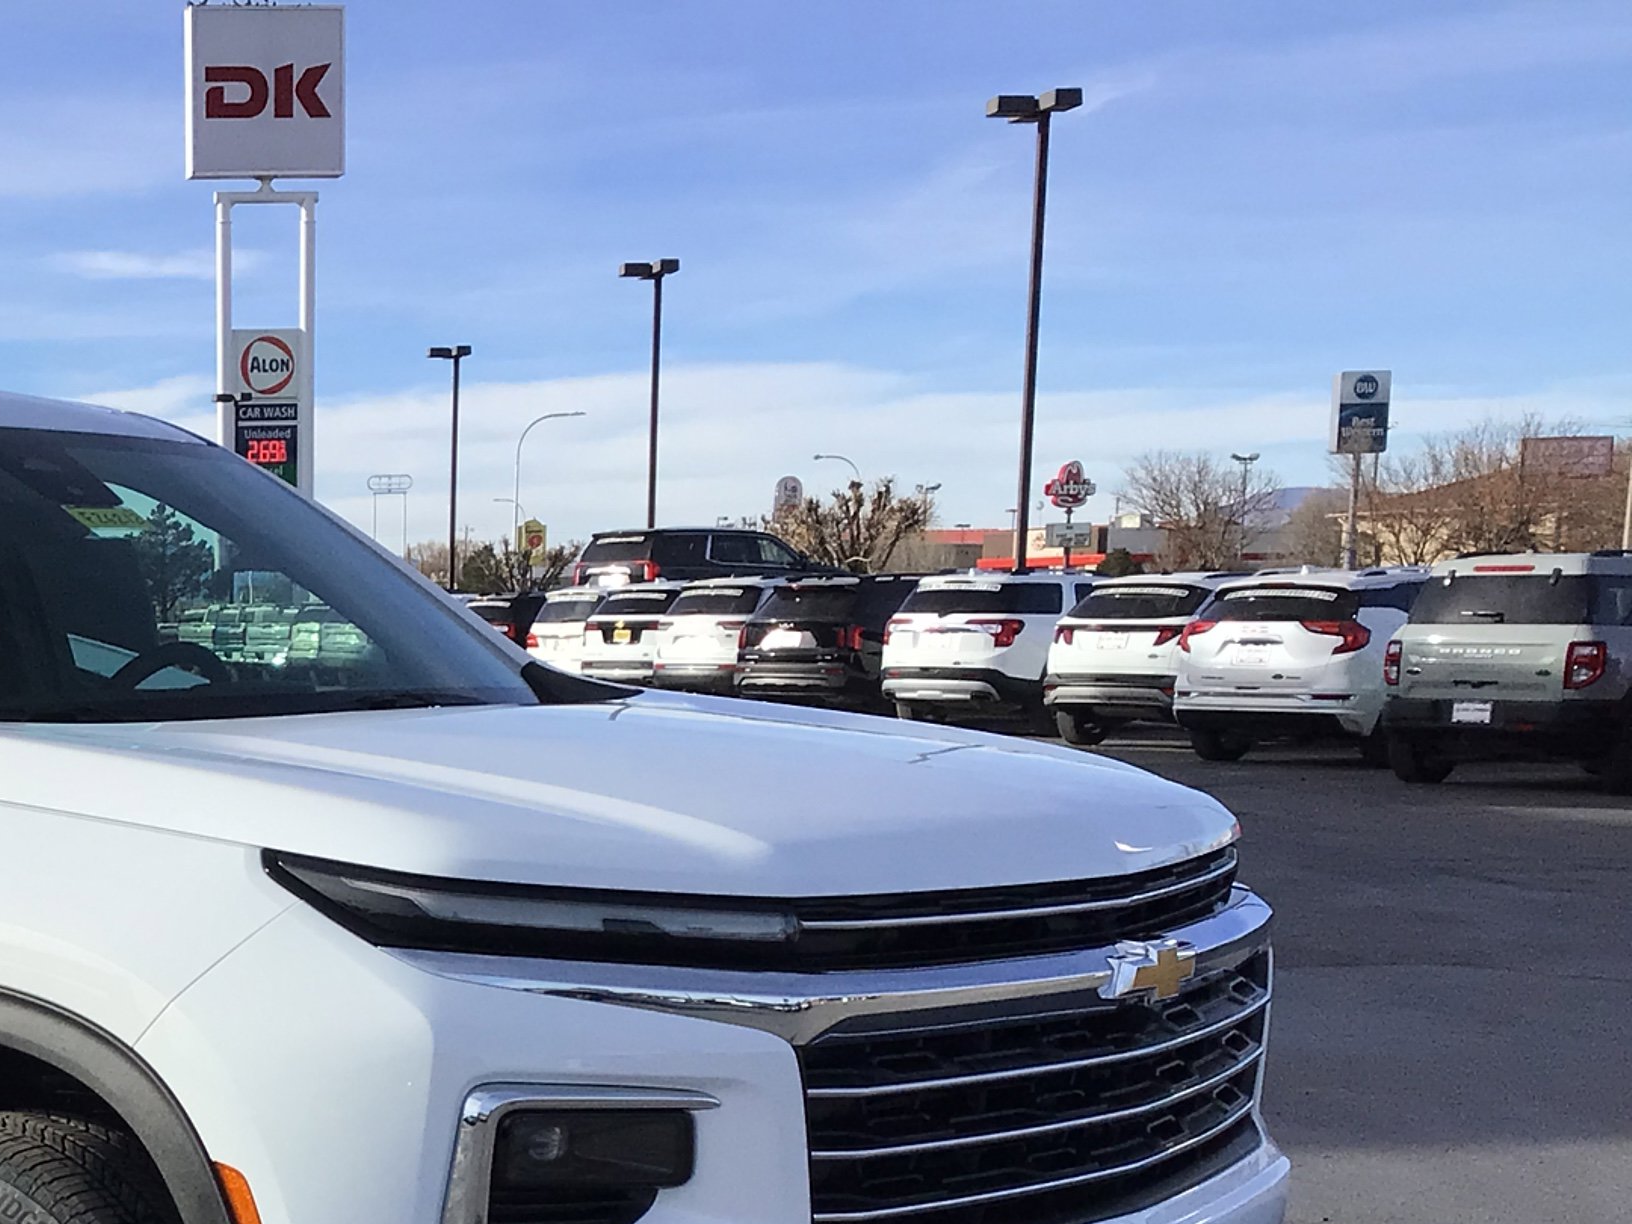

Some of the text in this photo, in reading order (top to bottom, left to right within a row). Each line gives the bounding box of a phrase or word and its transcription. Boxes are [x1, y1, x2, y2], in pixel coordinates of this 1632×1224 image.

[204, 62, 332, 120] DK
[250, 356, 291, 374] ALON
[239, 406, 296, 419] CAR WASH
[243, 428, 292, 440] Unleaded
